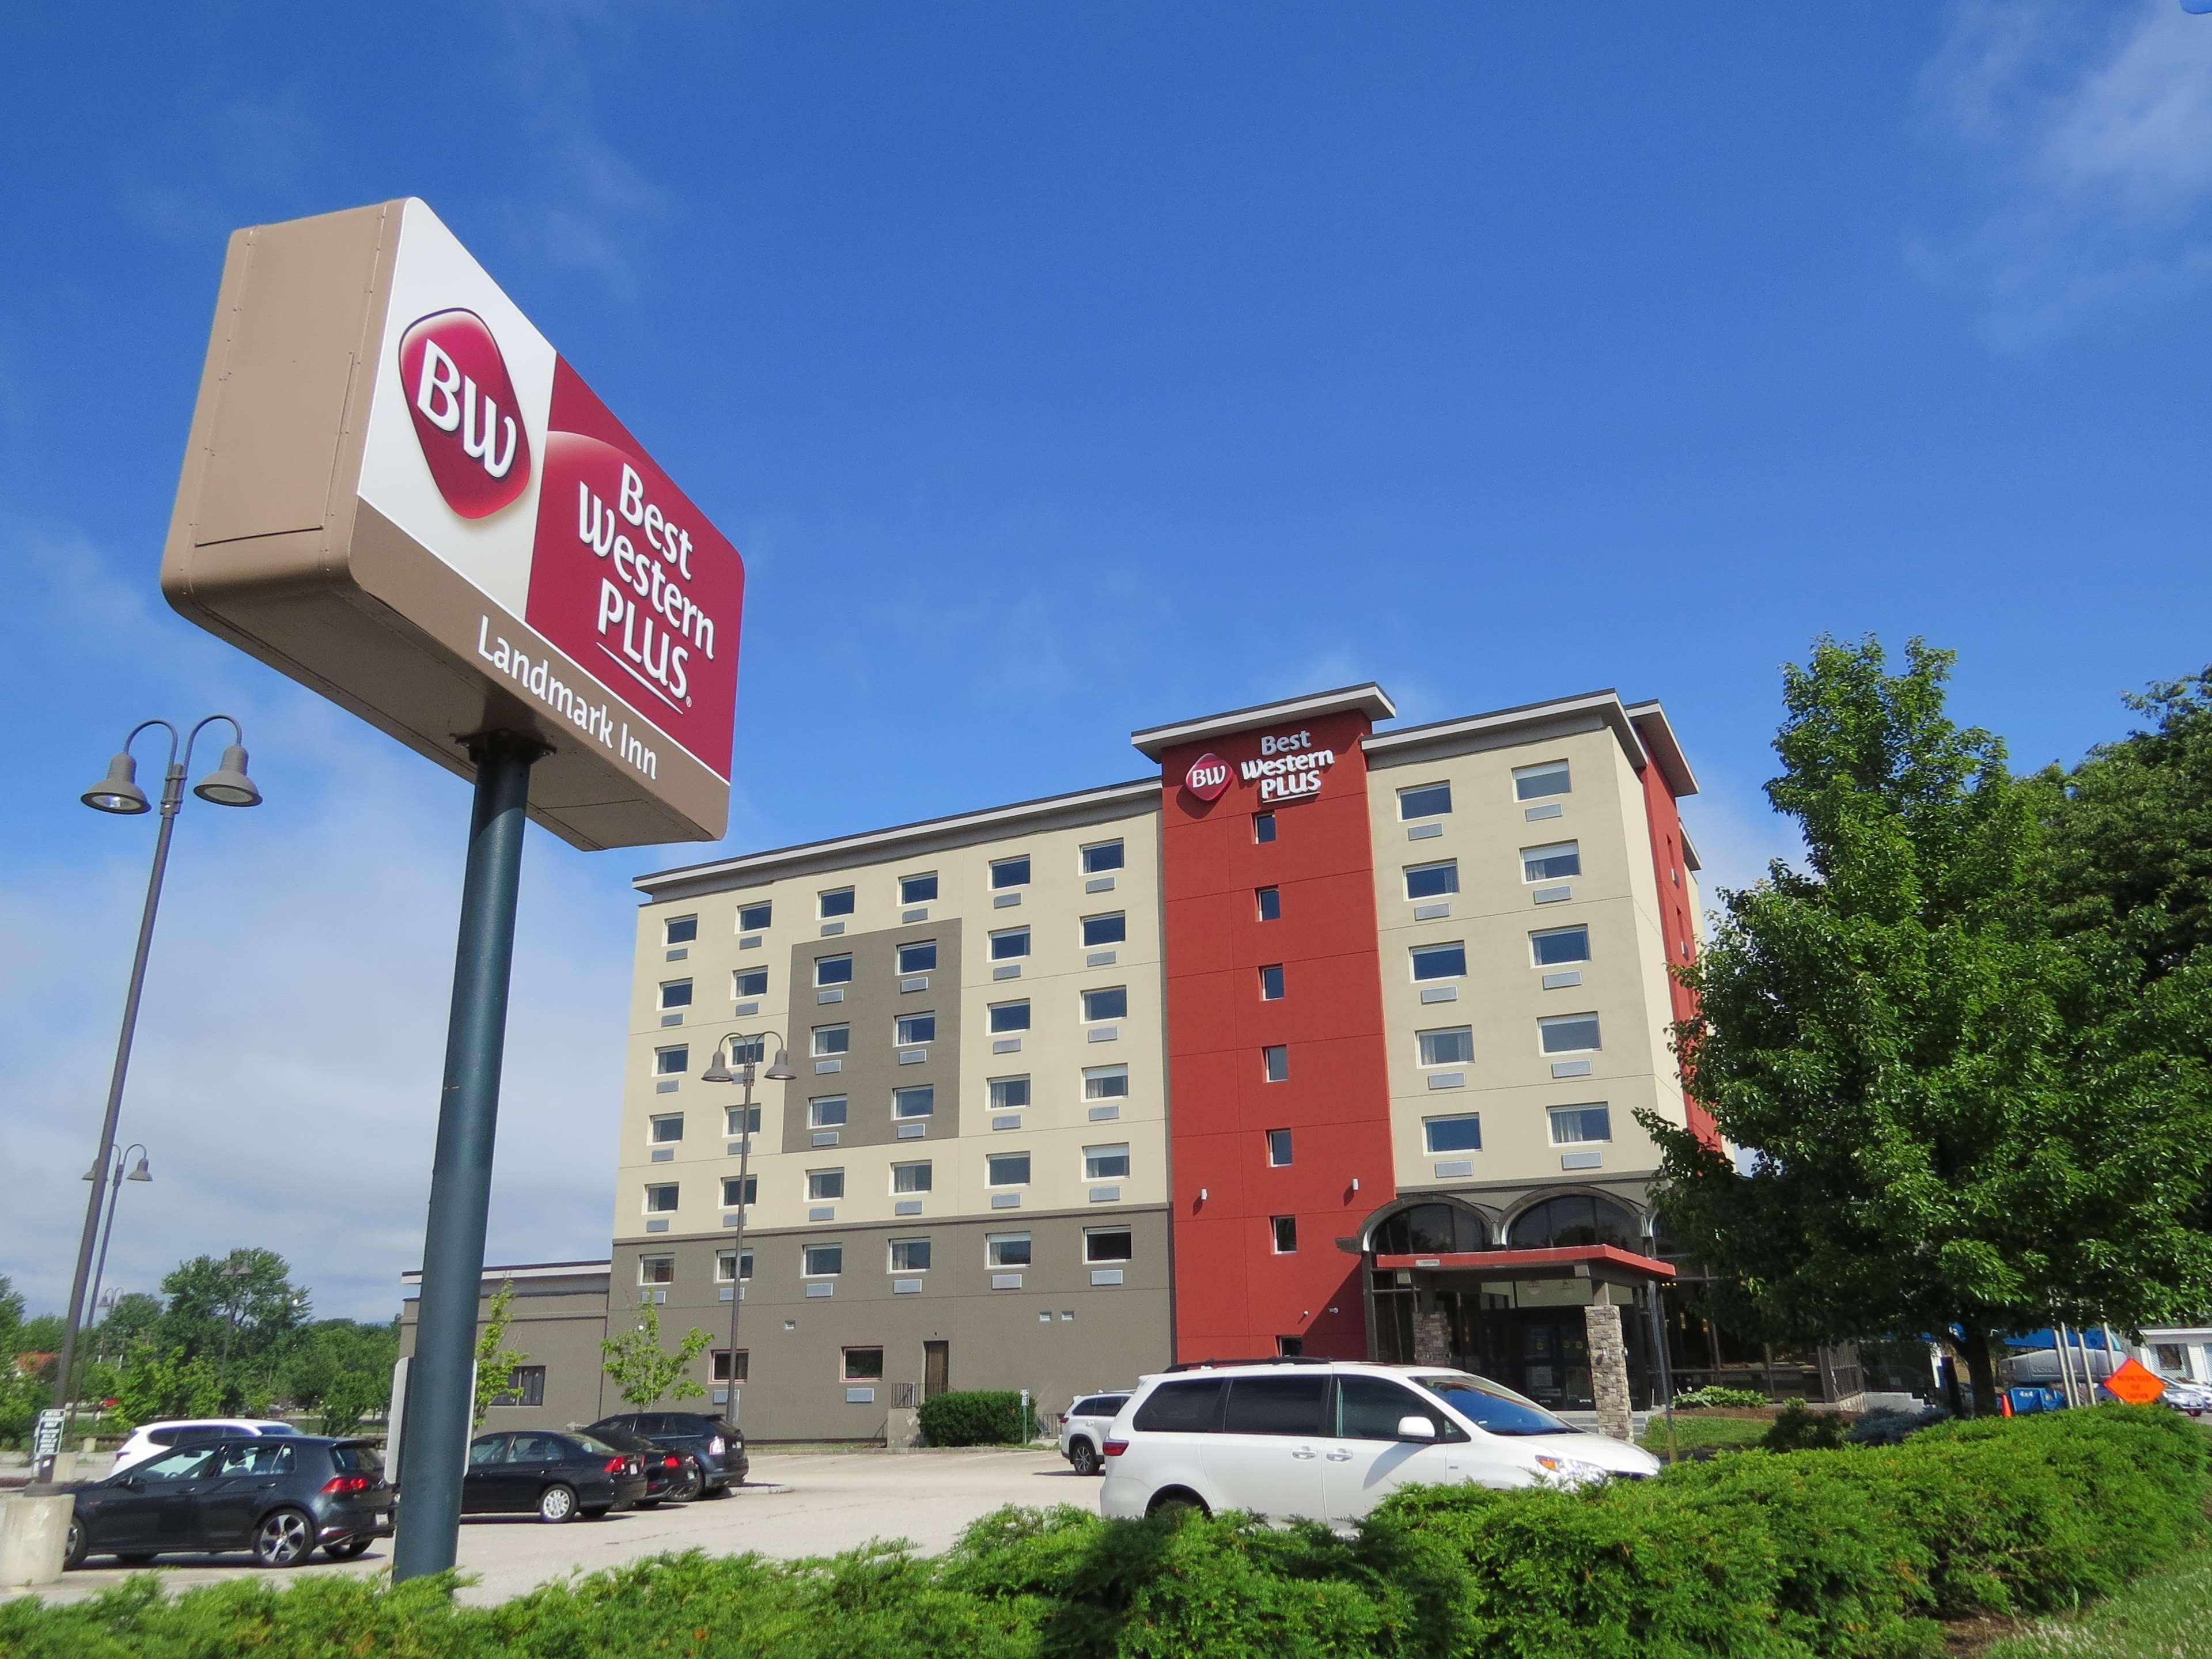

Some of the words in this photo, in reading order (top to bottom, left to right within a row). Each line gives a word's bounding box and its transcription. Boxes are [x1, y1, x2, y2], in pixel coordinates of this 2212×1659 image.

[416, 339, 517, 479] BW
[619, 463, 692, 581] Best
[579, 481, 714, 660] Western
[478, 615, 613, 750] Landmark
[620, 732, 657, 780] Inn
[1192, 764, 1226, 789] BW
[1241, 749, 1335, 780] Western
[1261, 729, 1312, 756] Best
[1261, 770, 1321, 800] PLUS
